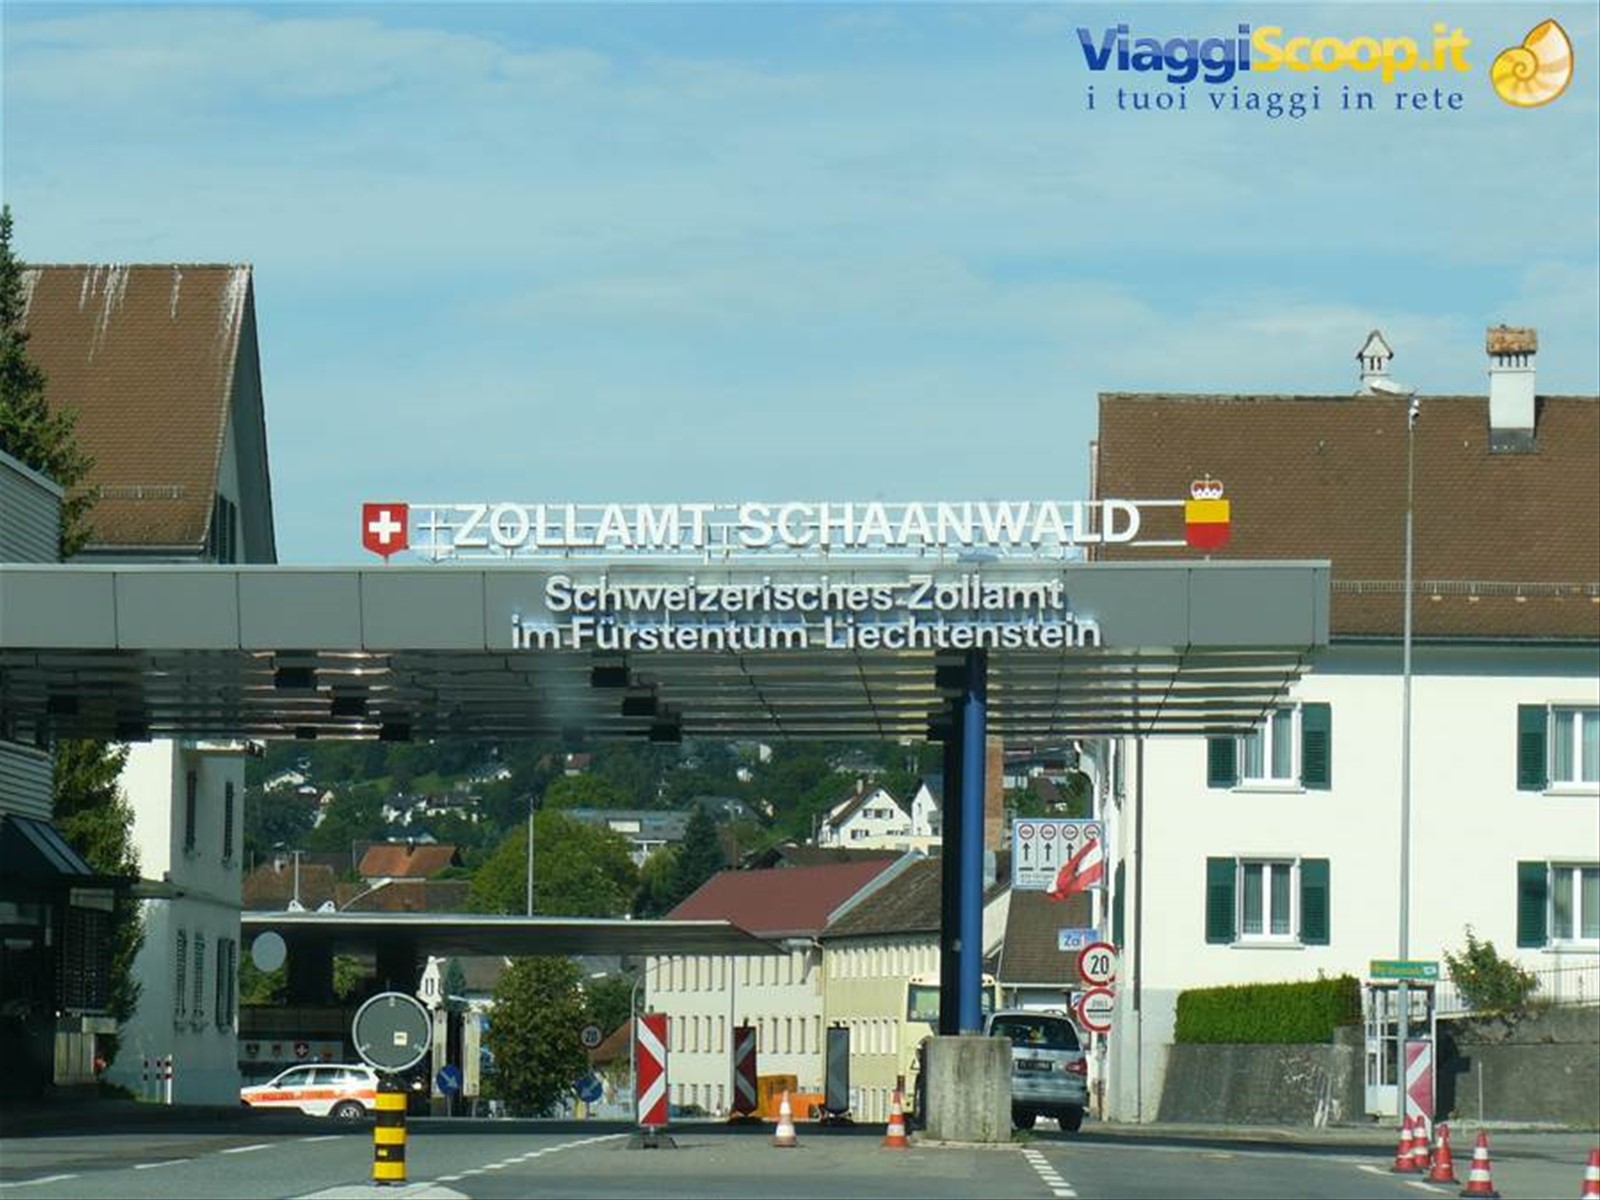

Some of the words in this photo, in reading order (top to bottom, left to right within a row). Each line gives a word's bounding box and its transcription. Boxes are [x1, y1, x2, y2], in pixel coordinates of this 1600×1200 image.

[453, 502, 715, 547] ZOLLAMT
[738, 500, 1140, 545] SCHAANWALD
[545, 575, 893, 611] Schweizerisches
[908, 574, 1064, 610] Zollamt
[511, 613, 561, 649] im
[571, 615, 808, 650] Fürstentum
[824, 612, 1100, 649] Liechtenstein
[1091, 955, 1109, 975] 20
